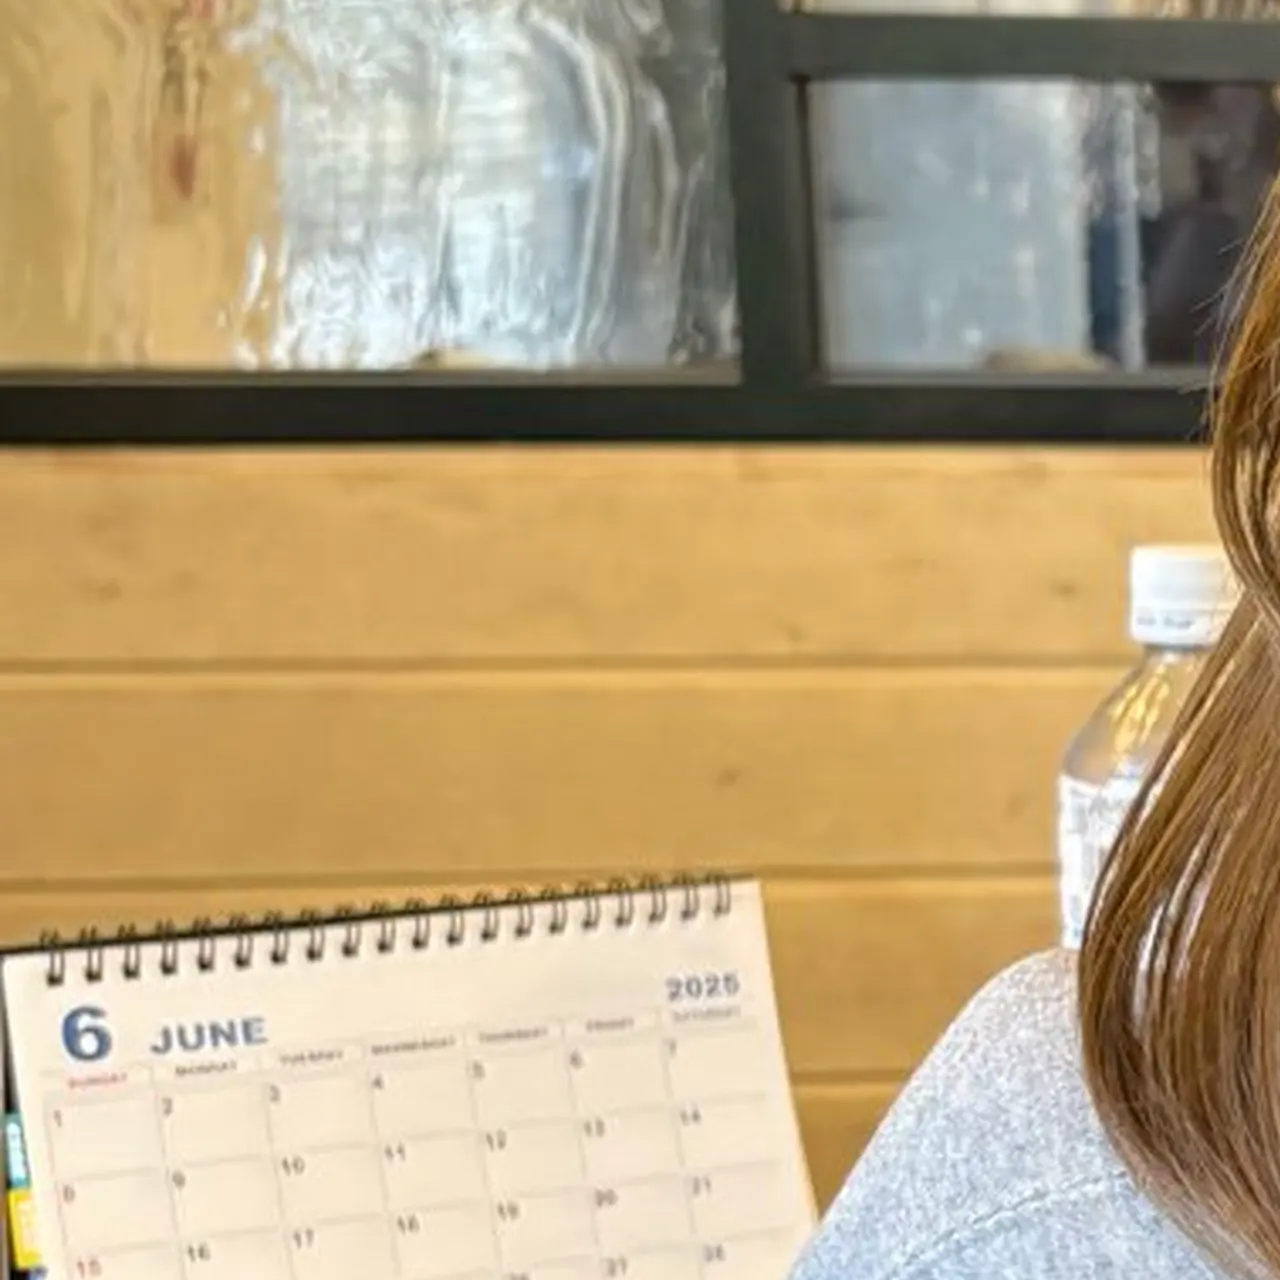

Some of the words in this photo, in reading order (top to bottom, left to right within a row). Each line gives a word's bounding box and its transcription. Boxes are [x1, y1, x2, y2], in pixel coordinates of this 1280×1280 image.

[665, 972, 741, 1001] 2025
[61, 1004, 113, 1062] 6
[150, 1017, 269, 1054] JUNE
